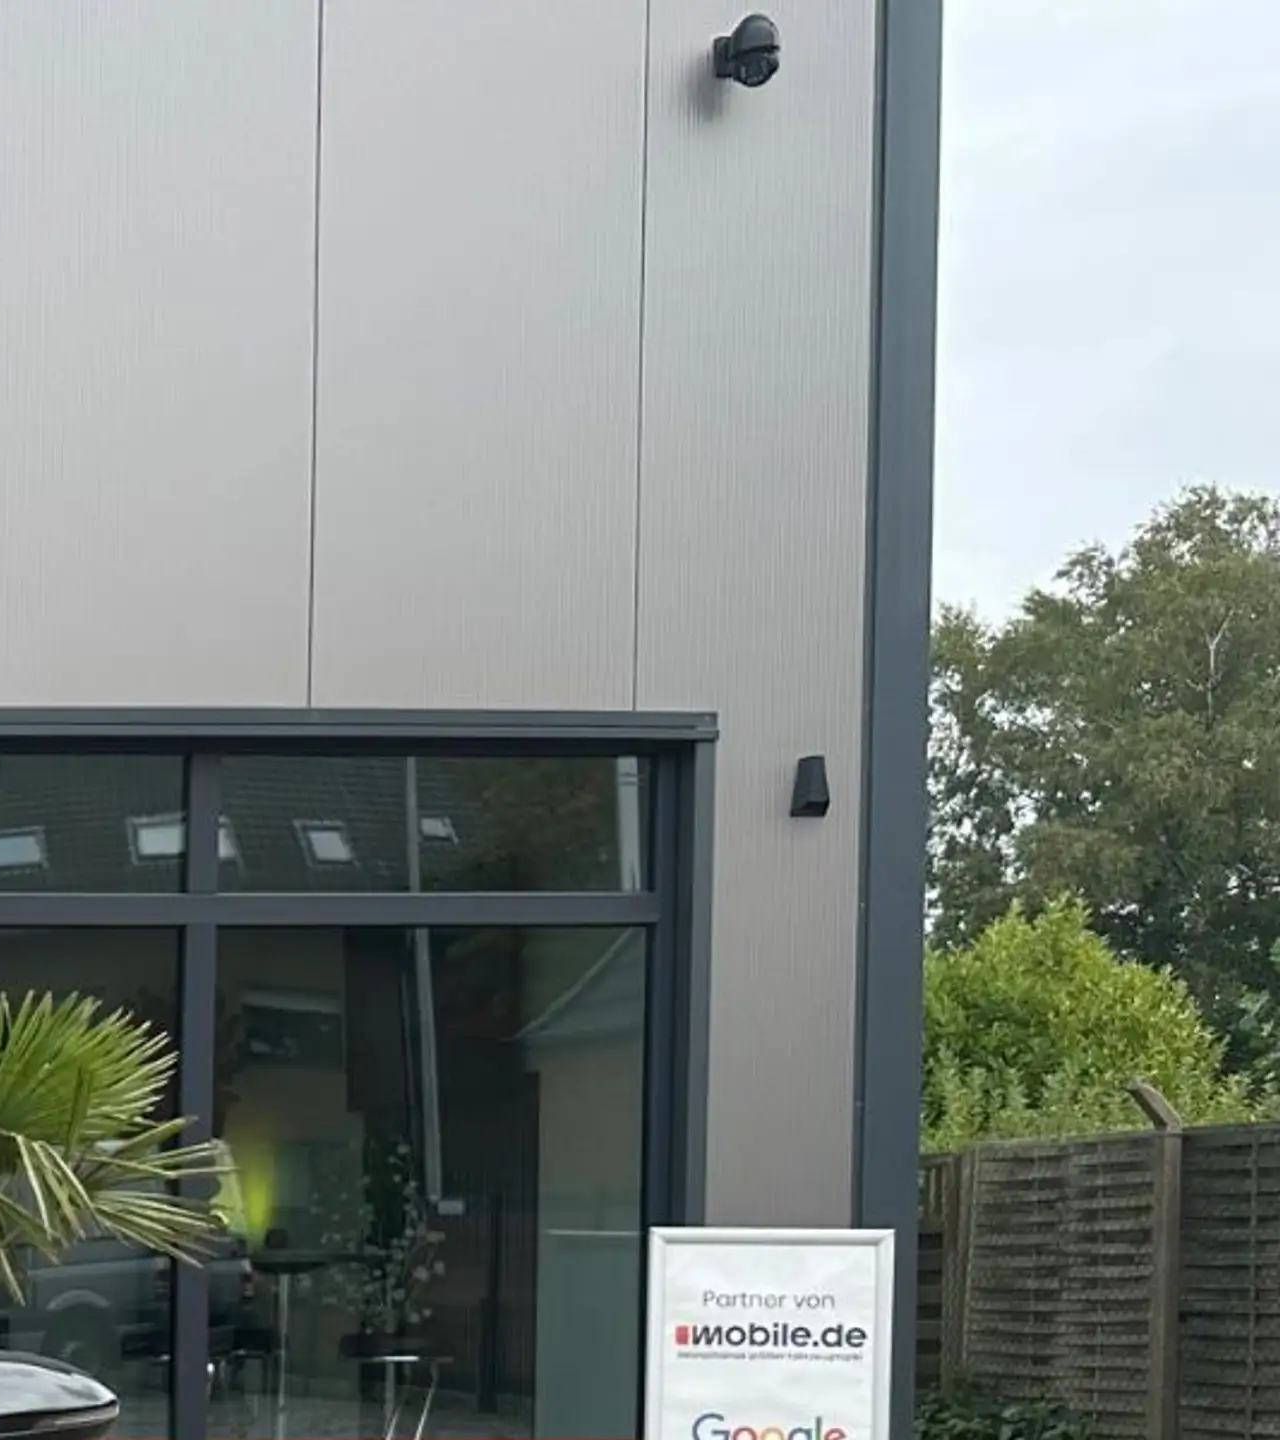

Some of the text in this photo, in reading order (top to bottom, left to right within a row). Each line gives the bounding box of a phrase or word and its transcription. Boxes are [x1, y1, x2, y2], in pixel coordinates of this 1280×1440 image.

[703, 1290, 836, 1309] Partner von
[692, 1322, 868, 1348] mobile.de
